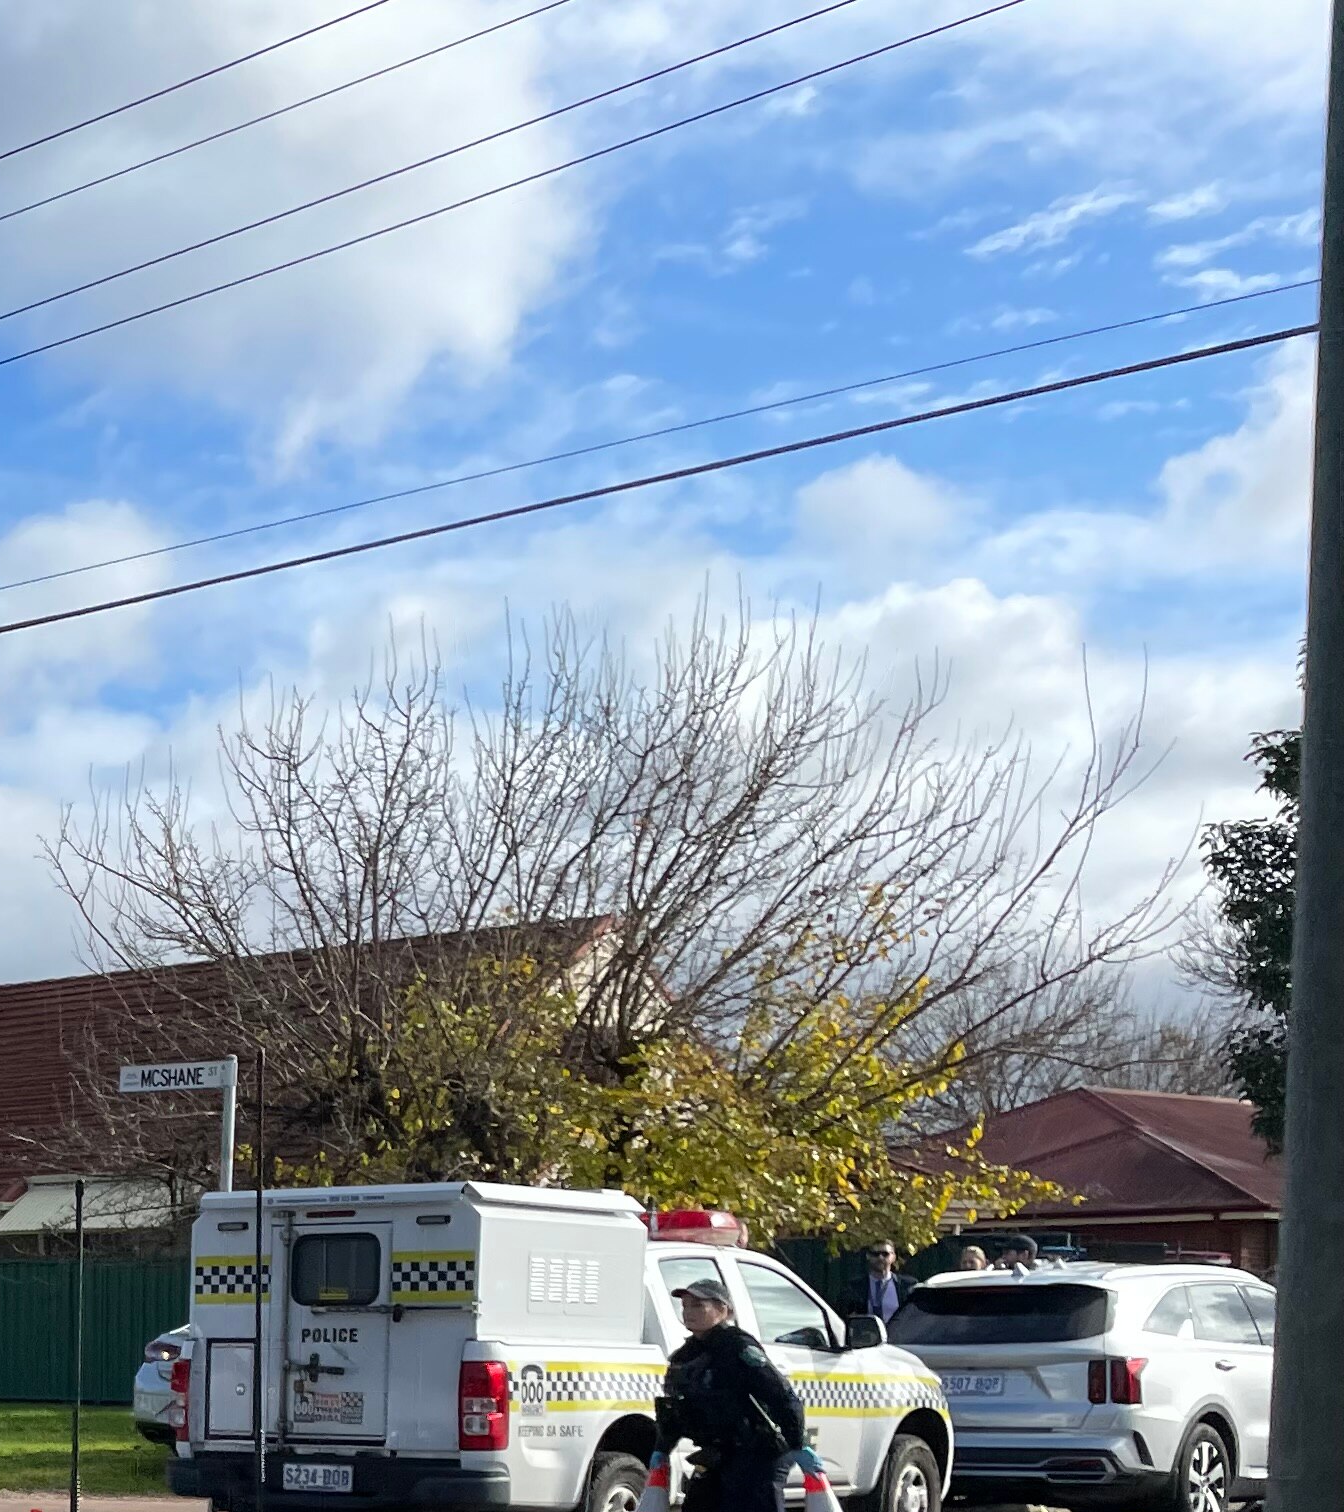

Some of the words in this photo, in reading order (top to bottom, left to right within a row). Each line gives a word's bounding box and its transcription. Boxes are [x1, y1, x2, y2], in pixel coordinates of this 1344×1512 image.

[141, 1067, 205, 1088] MCSHANE
[301, 1327, 359, 1343] POLICE
[546, 1425, 557, 1437] SA
[559, 1425, 585, 1437] SAFE
